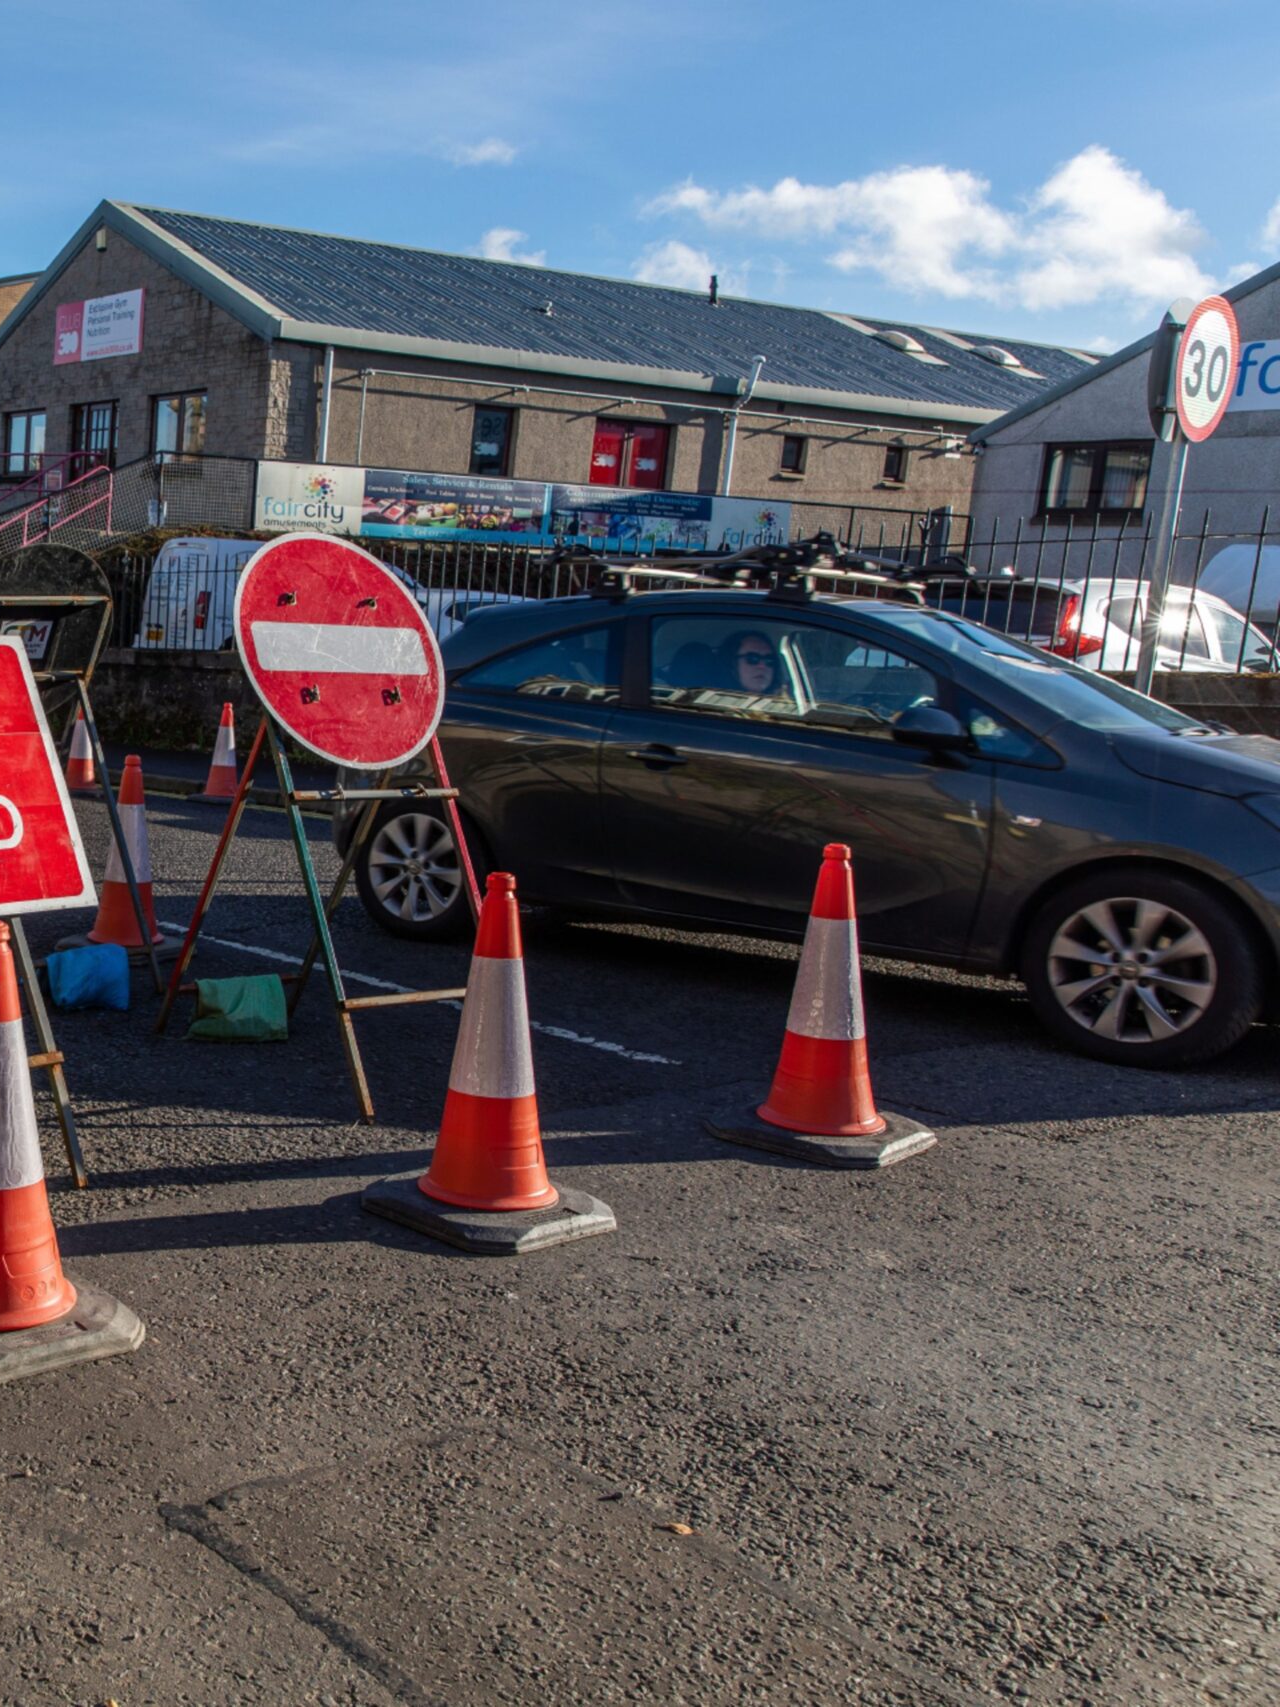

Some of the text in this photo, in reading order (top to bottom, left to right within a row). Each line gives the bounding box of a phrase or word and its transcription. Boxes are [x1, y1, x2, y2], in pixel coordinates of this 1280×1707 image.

[1184, 339, 1229, 403] 30
[433, 476, 466, 488] Service
[468, 479, 475, 488] &
[477, 480, 513, 491] Rentals
[264, 496, 344, 524] faircity
[263, 518, 327, 529] amusements
